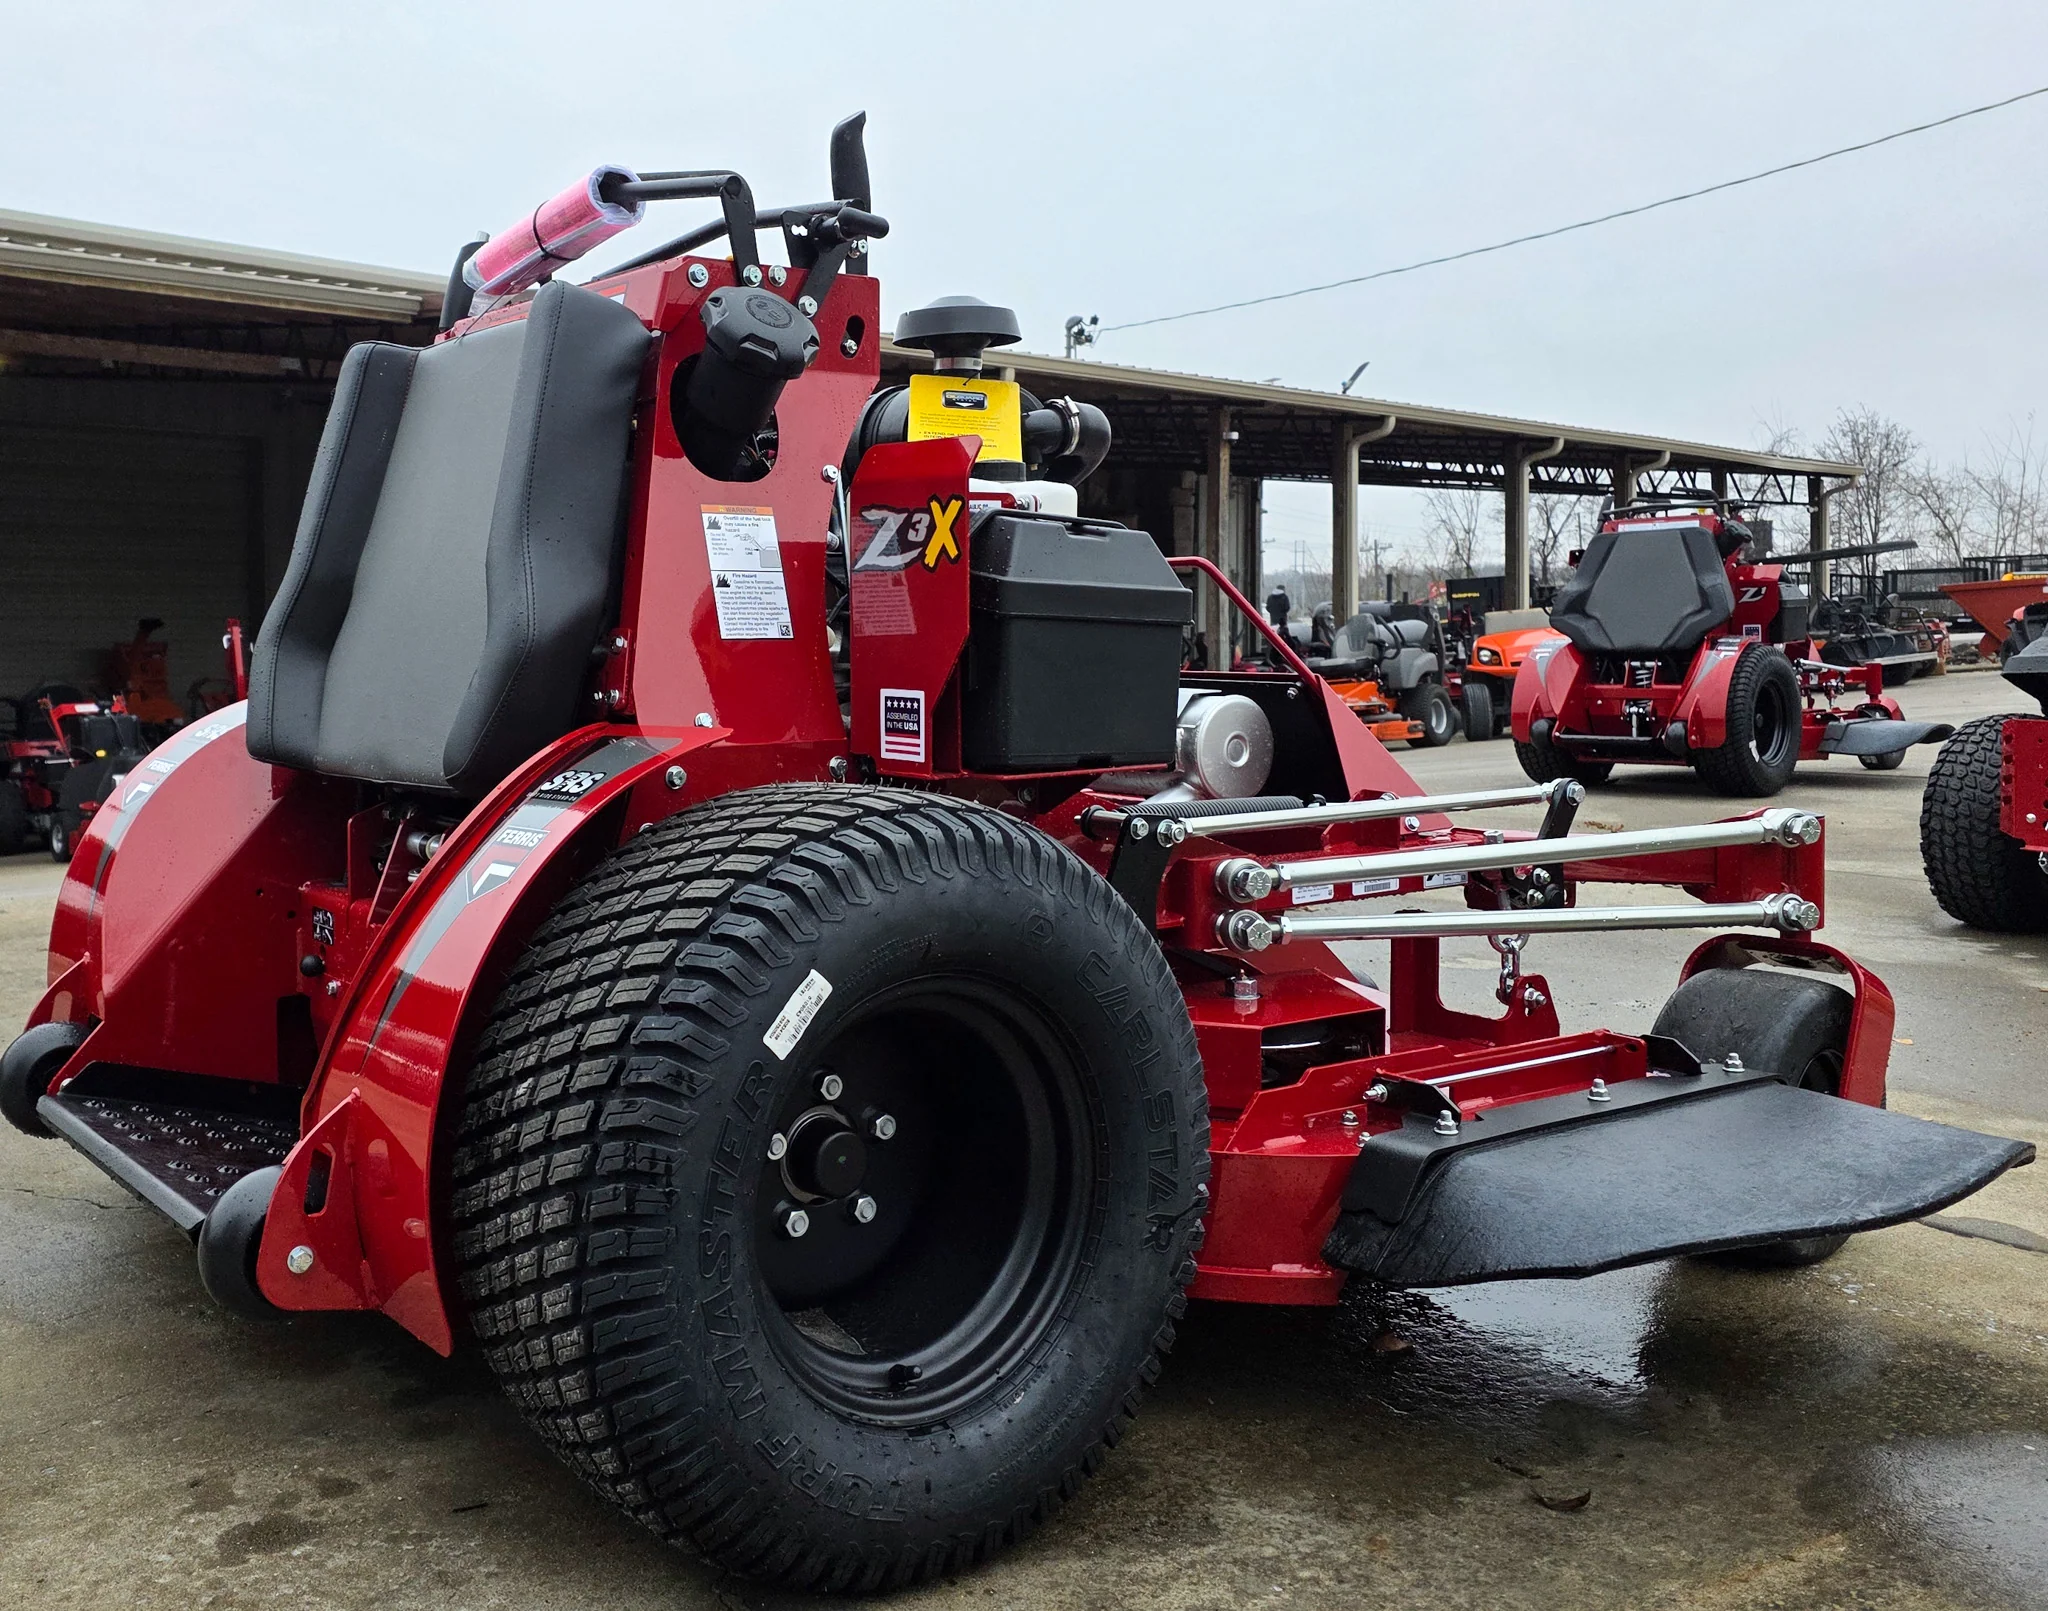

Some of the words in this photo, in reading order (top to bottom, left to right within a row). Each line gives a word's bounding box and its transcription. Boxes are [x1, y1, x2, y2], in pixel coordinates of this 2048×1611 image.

[886, 712, 918, 721] ASSEMBLED
[904, 722, 918, 731] USA
[498, 830, 542, 847] FERRIS
[1075, 950, 1180, 1253] CARLSTAR
[700, 1060, 776, 1420] MASTER
[754, 1431, 907, 1522] TURF
